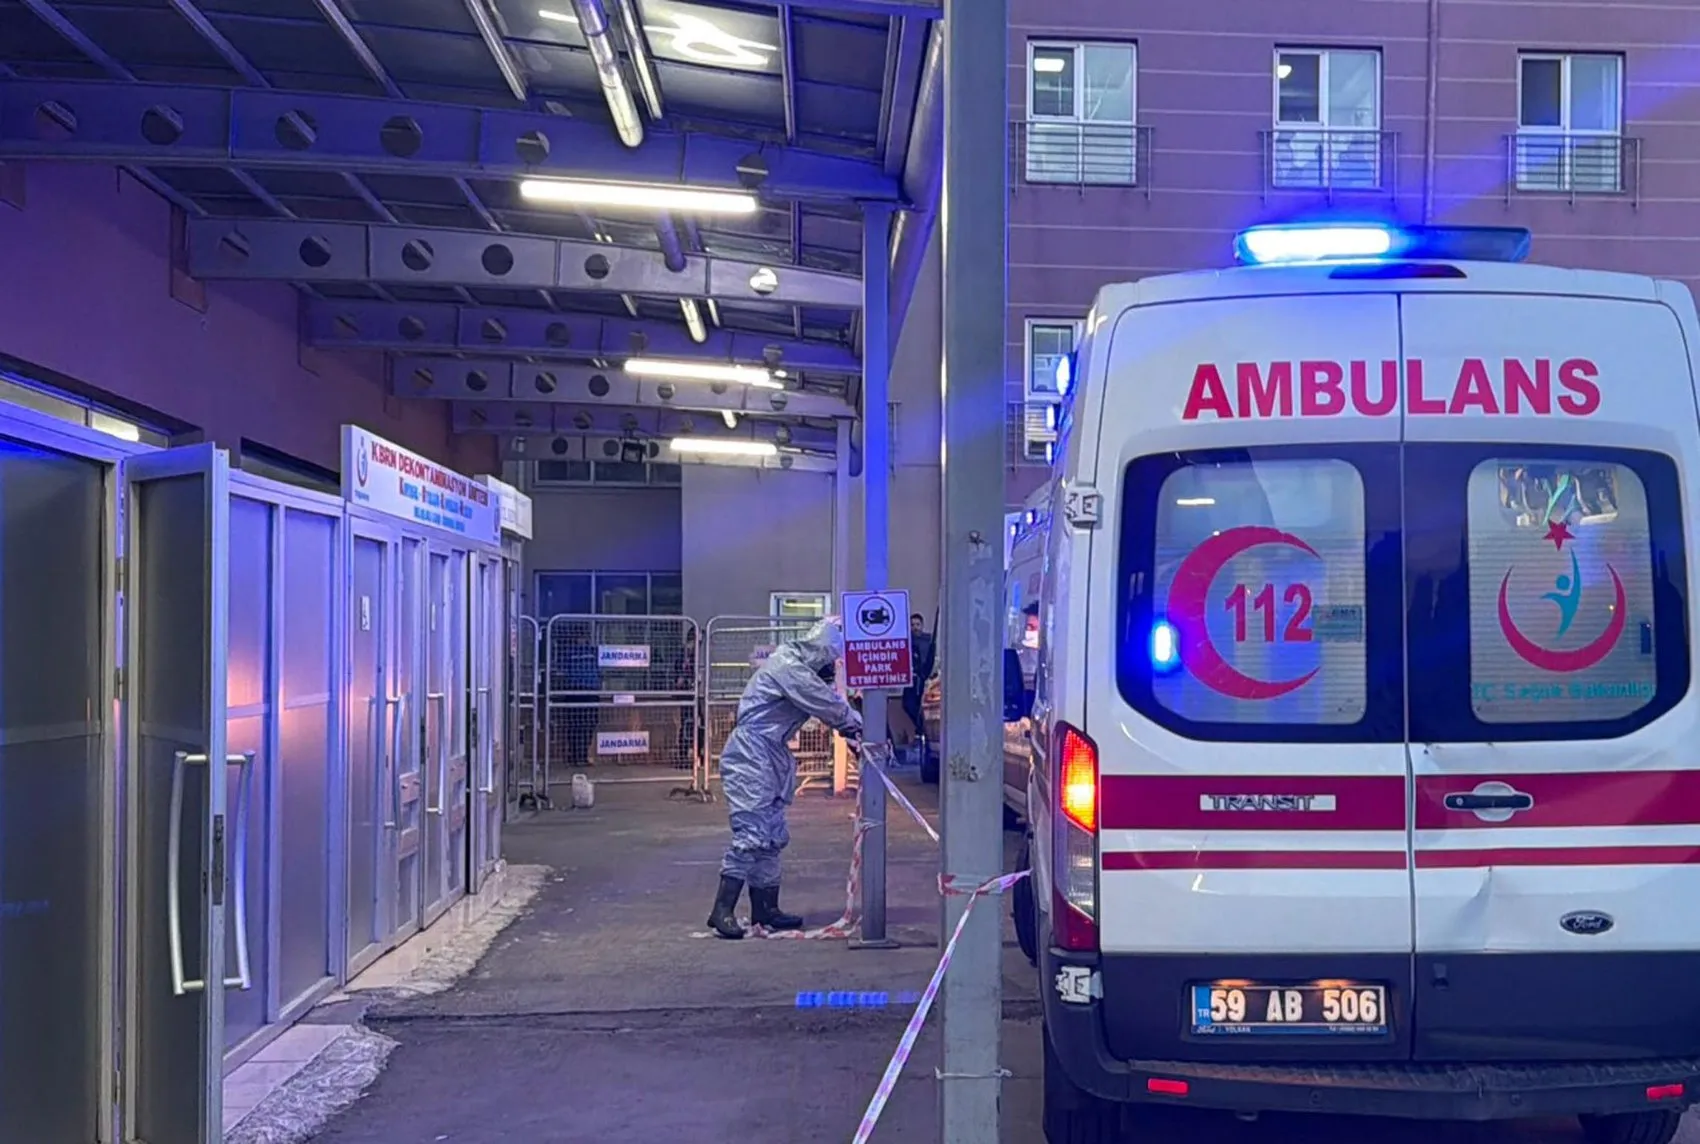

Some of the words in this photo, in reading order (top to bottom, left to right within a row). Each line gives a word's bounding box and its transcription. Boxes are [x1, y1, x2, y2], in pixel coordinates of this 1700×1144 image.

[1182, 357, 1601, 421] AMBULANS
[1224, 583, 1313, 643] 112
[848, 640, 906, 652] AMBULANS
[600, 650, 647, 661] JANDARMA
[857, 650, 899, 664] İÇİNDİR
[864, 663, 893, 674] PARK
[849, 672, 908, 685] ETMEYİNİZ
[599, 738, 648, 749] JANDARMA
[1208, 794, 1316, 811] TRANSIT
[1197, 1008, 1210, 1018] TR
[1211, 988, 1246, 1022] 59
[1265, 989, 1303, 1022] AB
[1322, 989, 1378, 1023] 506
